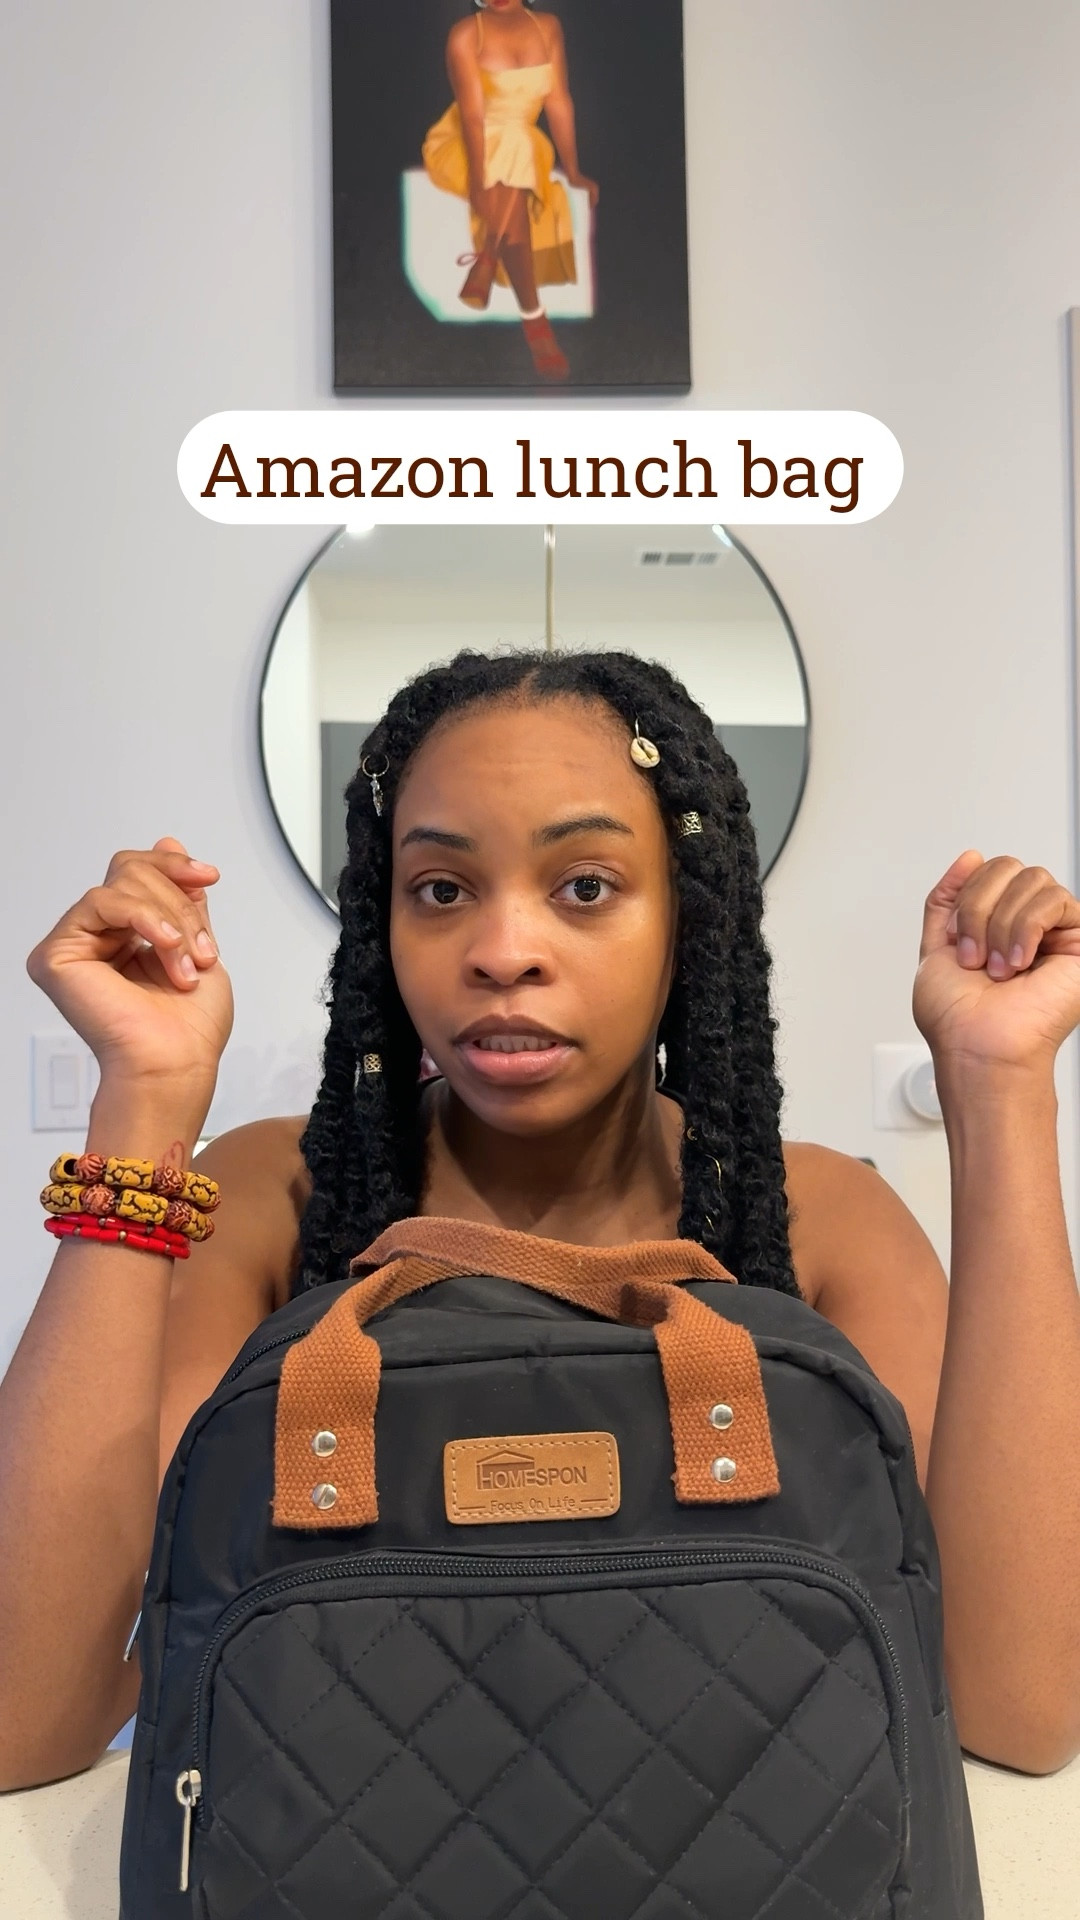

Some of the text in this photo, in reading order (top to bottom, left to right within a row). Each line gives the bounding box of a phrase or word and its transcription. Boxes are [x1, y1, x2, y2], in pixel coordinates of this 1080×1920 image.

[479, 1464, 587, 1490] HOMESPON
[490, 1496, 576, 1511] Focus On Life
